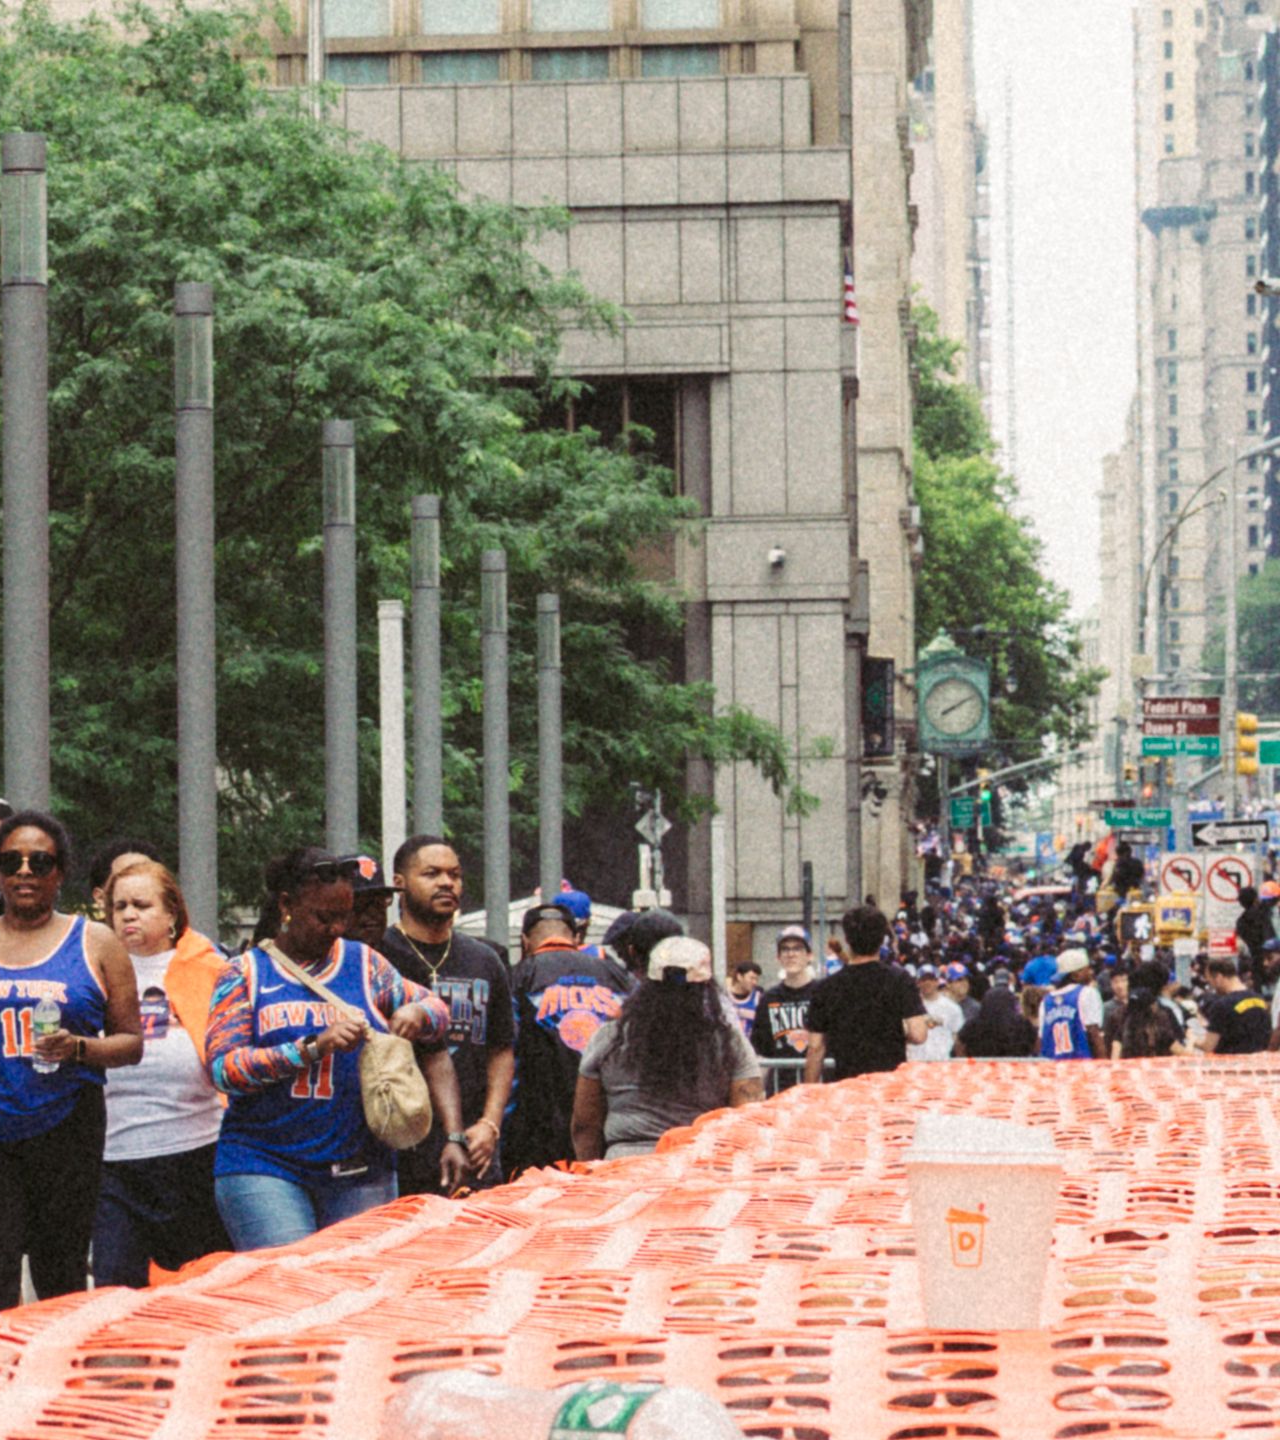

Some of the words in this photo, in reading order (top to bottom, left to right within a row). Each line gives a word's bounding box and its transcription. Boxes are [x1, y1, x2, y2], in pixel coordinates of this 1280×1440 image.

[14, 980, 68, 1004] YORK
[0, 1006, 34, 1059] 11
[258, 1001, 309, 1037] NEW
[768, 1004, 809, 1036] KNIC
[290, 1049, 335, 1100] 11
[958, 1231, 977, 1252] D
